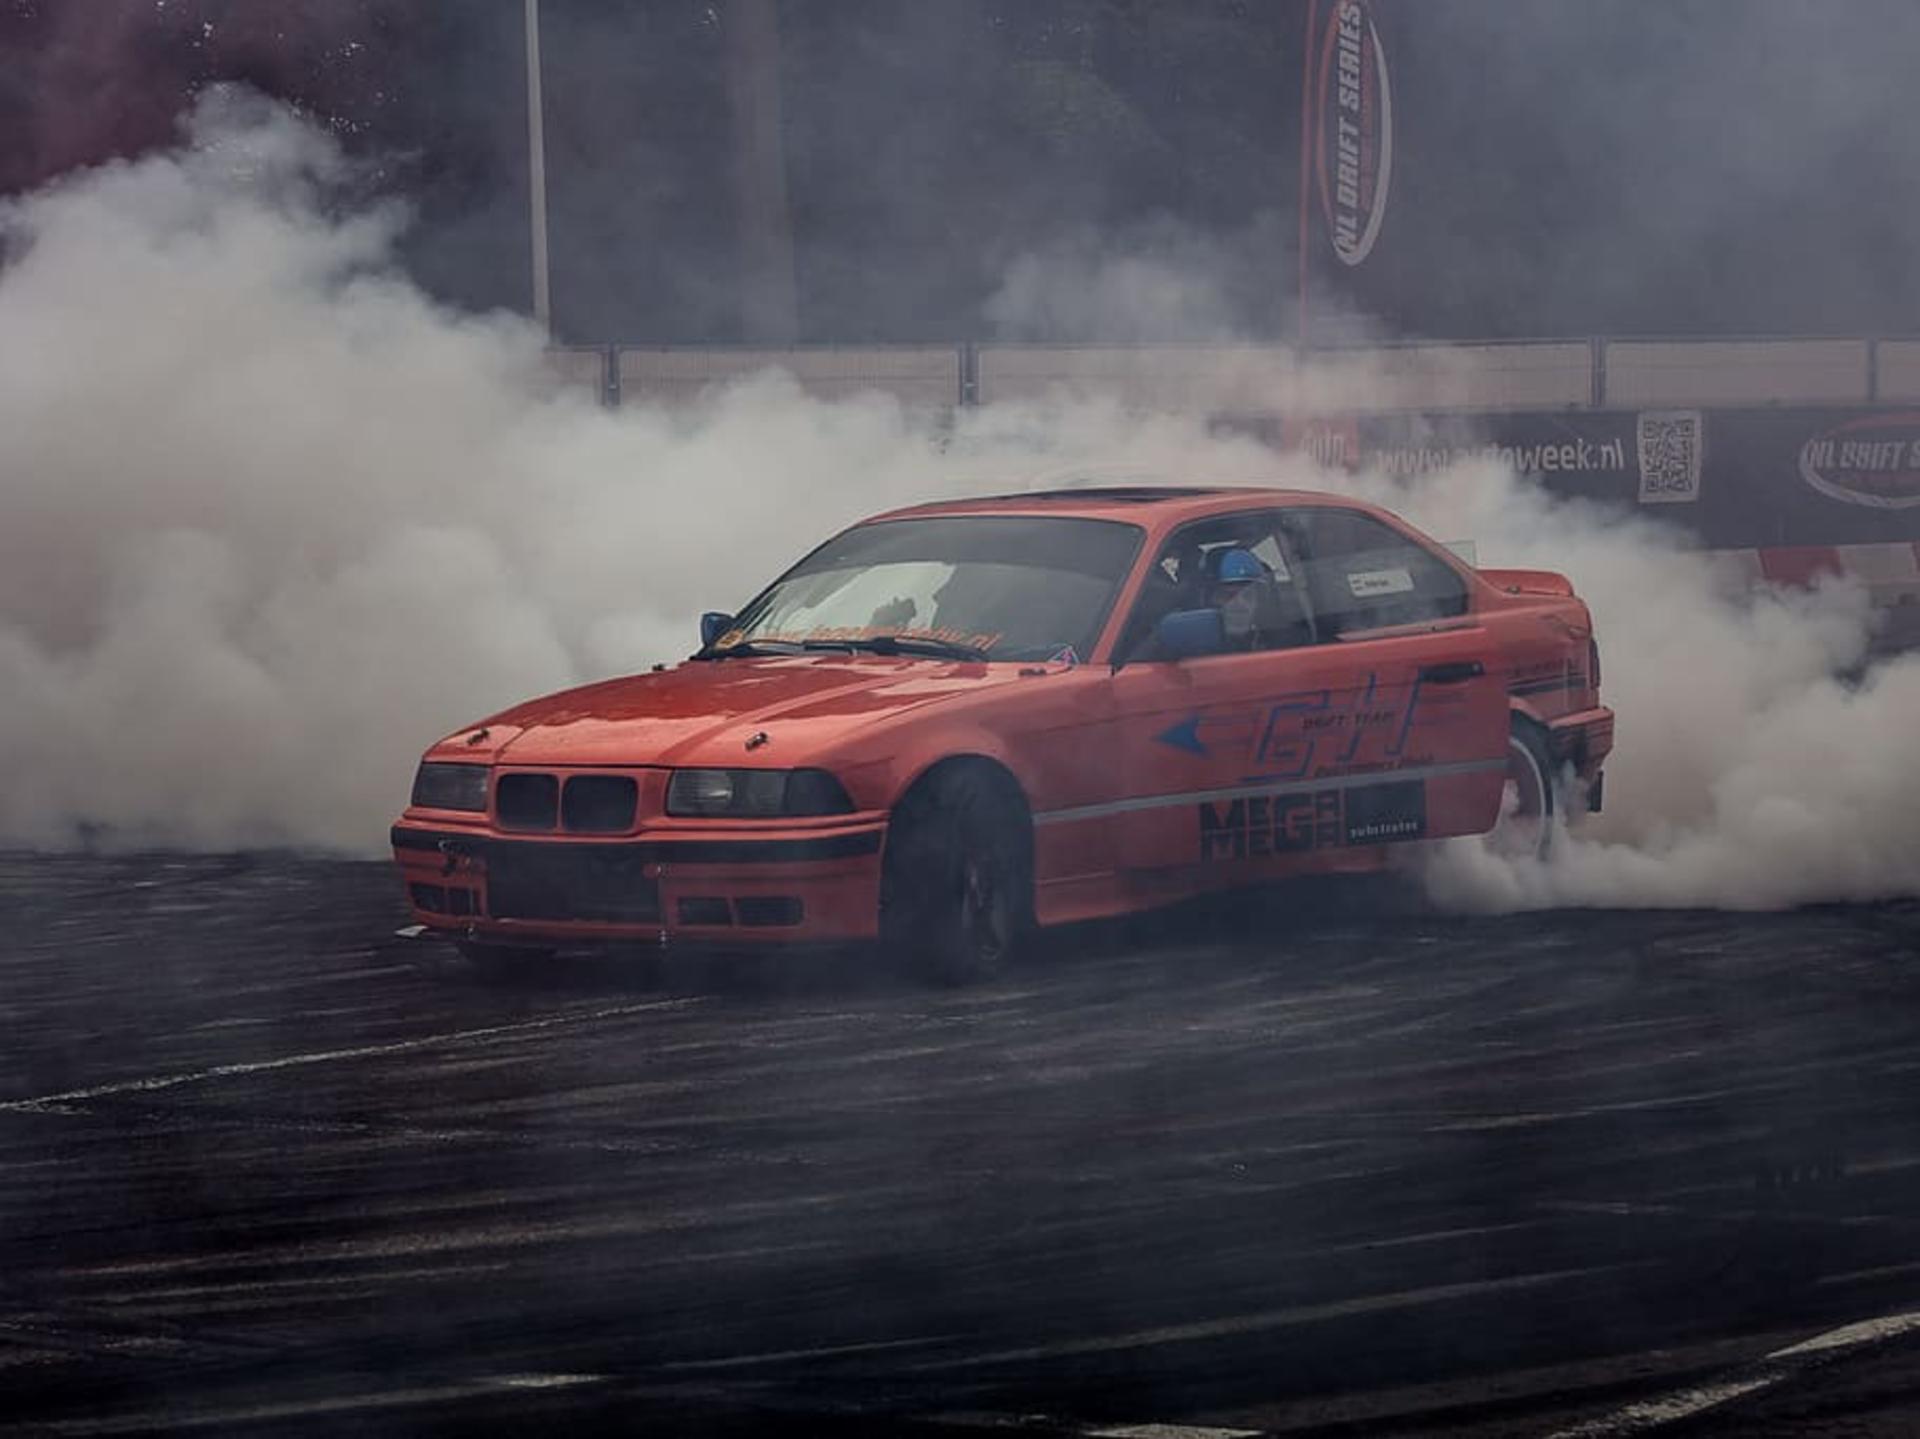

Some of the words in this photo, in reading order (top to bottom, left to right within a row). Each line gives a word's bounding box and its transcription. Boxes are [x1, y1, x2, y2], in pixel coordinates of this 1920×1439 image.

[1338, 1, 1361, 111] SERIES
[1336, 116, 1359, 211] DRIFT
[1378, 437, 1626, 474] www.atoweek.nl
[1840, 440, 1906, 471] DRIFT
